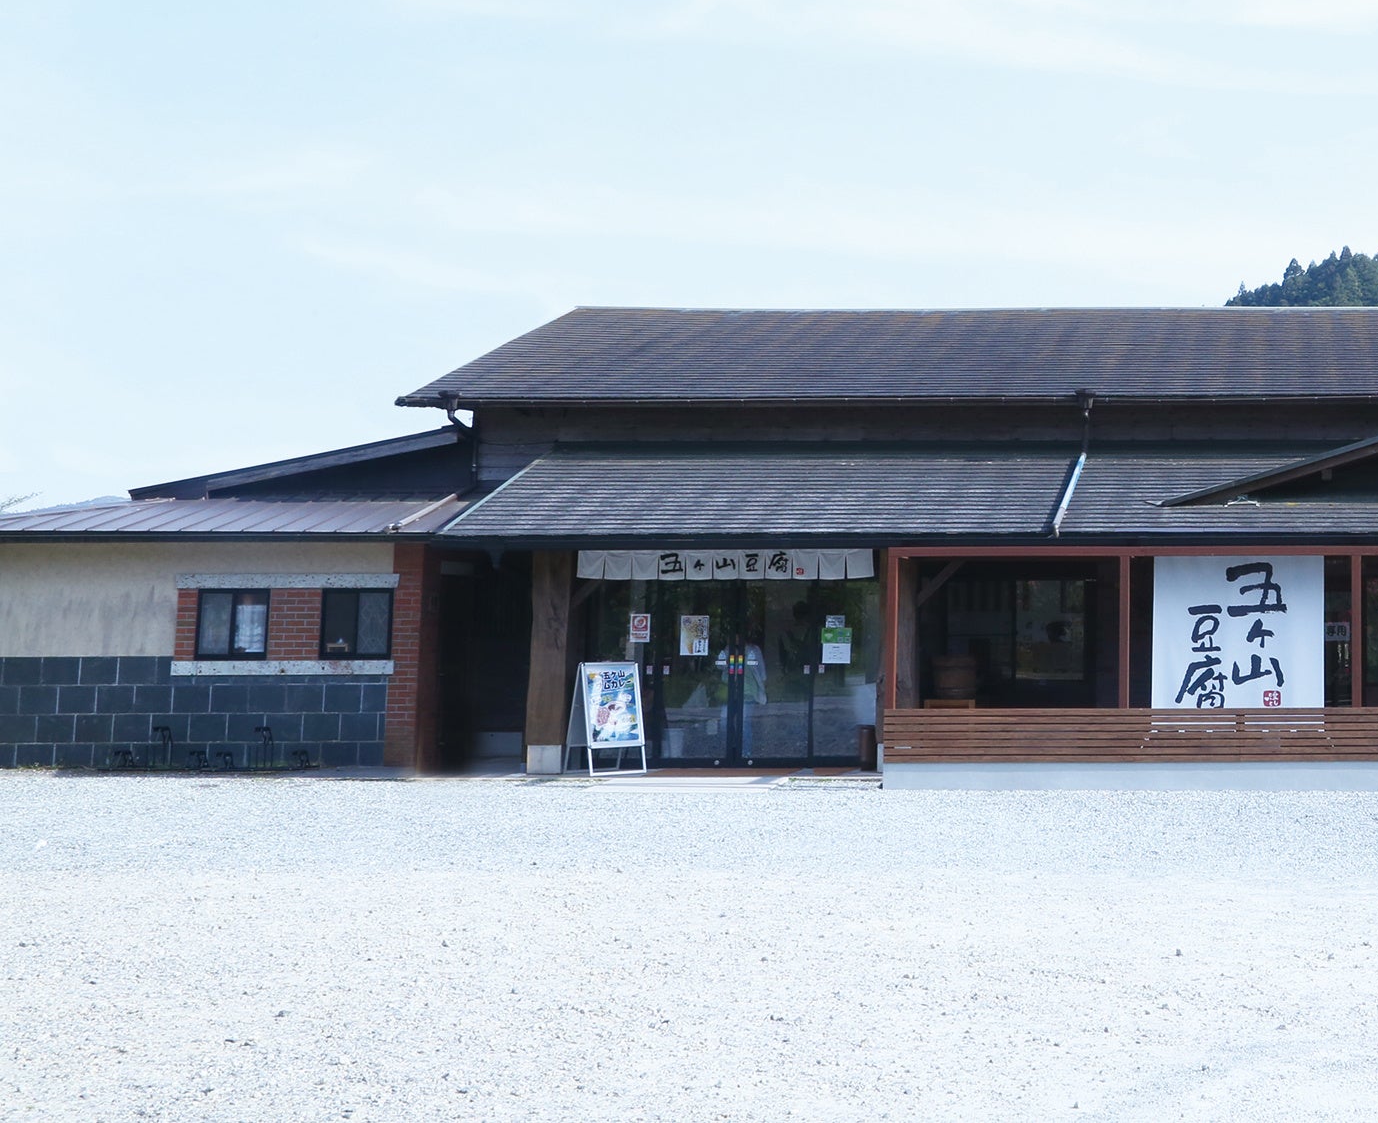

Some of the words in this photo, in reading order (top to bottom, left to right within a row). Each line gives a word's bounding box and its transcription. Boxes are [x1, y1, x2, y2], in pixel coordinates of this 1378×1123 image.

[598, 679, 632, 690] ムカレー
[1175, 604, 1228, 708] 豆腐
